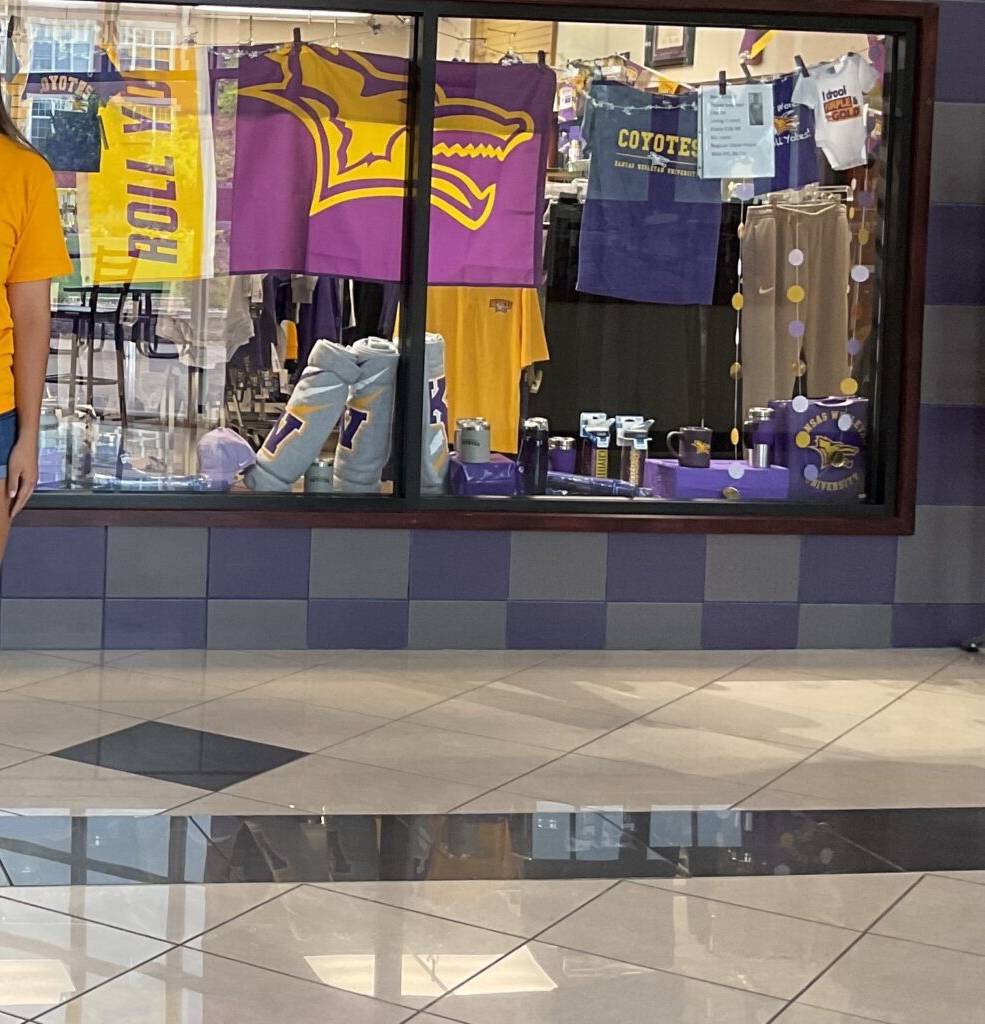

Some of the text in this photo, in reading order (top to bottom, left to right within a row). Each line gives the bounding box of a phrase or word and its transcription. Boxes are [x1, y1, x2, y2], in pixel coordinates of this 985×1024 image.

[826, 85, 847, 99] drool
[831, 107, 860, 121] GOLD
[126, 156, 179, 264] ROLL
